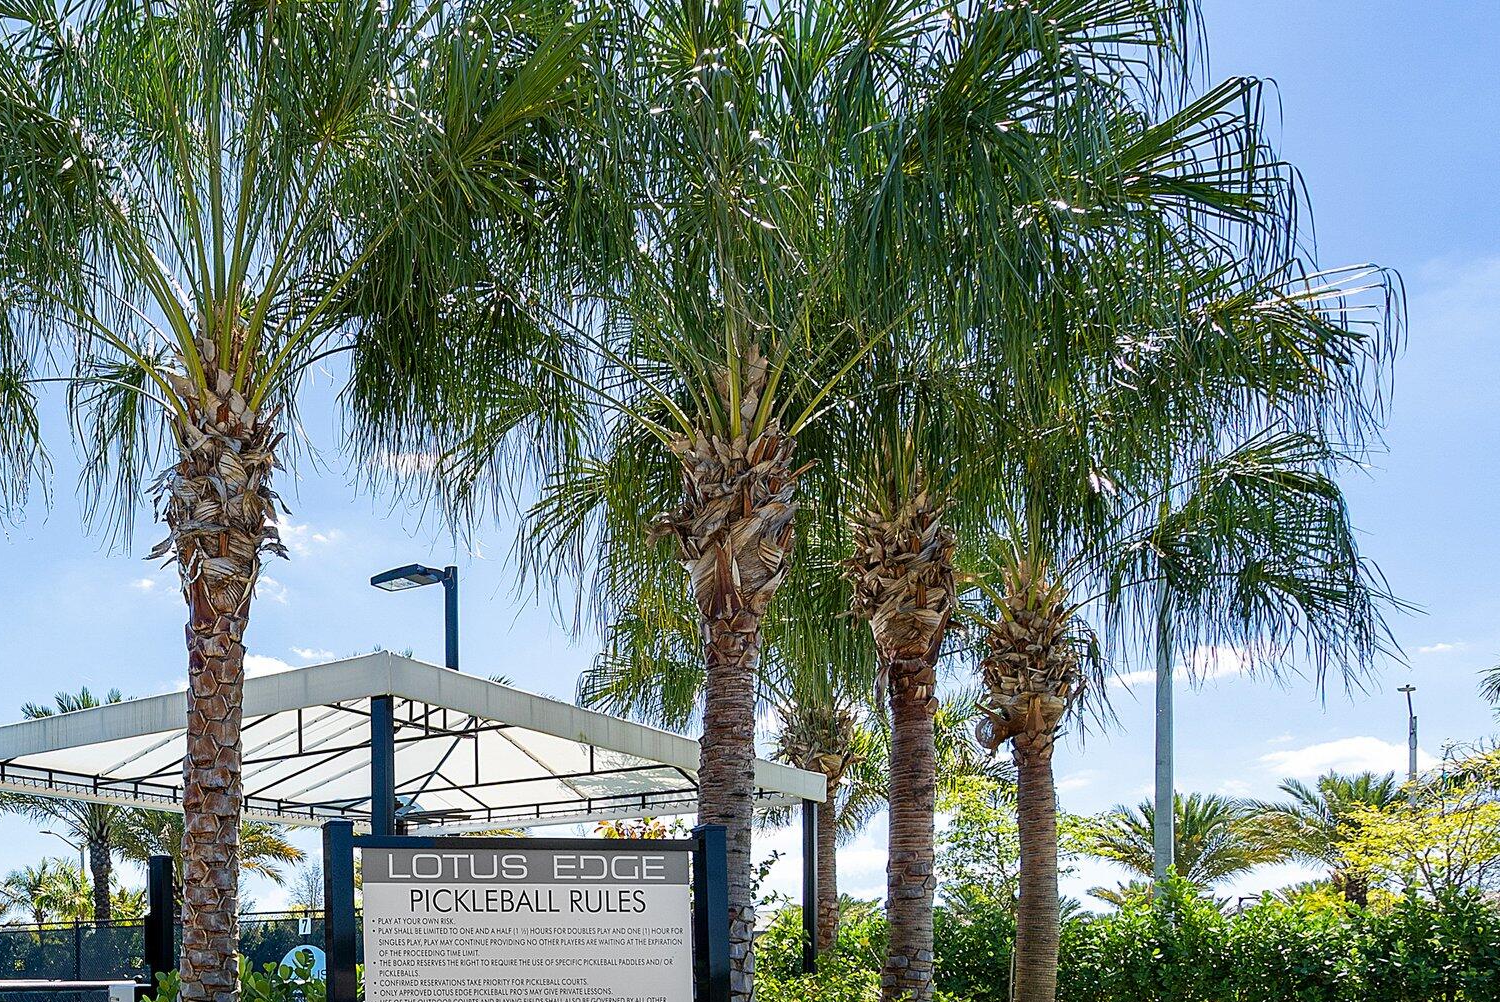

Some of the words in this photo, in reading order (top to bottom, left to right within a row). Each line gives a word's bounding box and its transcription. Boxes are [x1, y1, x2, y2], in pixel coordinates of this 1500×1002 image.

[388, 853, 528, 879] LOTUS
[553, 855, 666, 880] EDGE
[410, 889, 560, 913] PICKLEBALL
[570, 890, 646, 913] RULES
[302, 919, 308, 933] 7
[379, 979, 419, 987] CONFIRMED
[419, 979, 465, 987] RESERVATIONS
[380, 989, 397, 997] ONLY
[398, 989, 432, 997] APPROVED
[473, 988, 508, 996] PICKLEBALL
[509, 988, 528, 996] PRO'S
[529, 988, 542, 996] MAY
